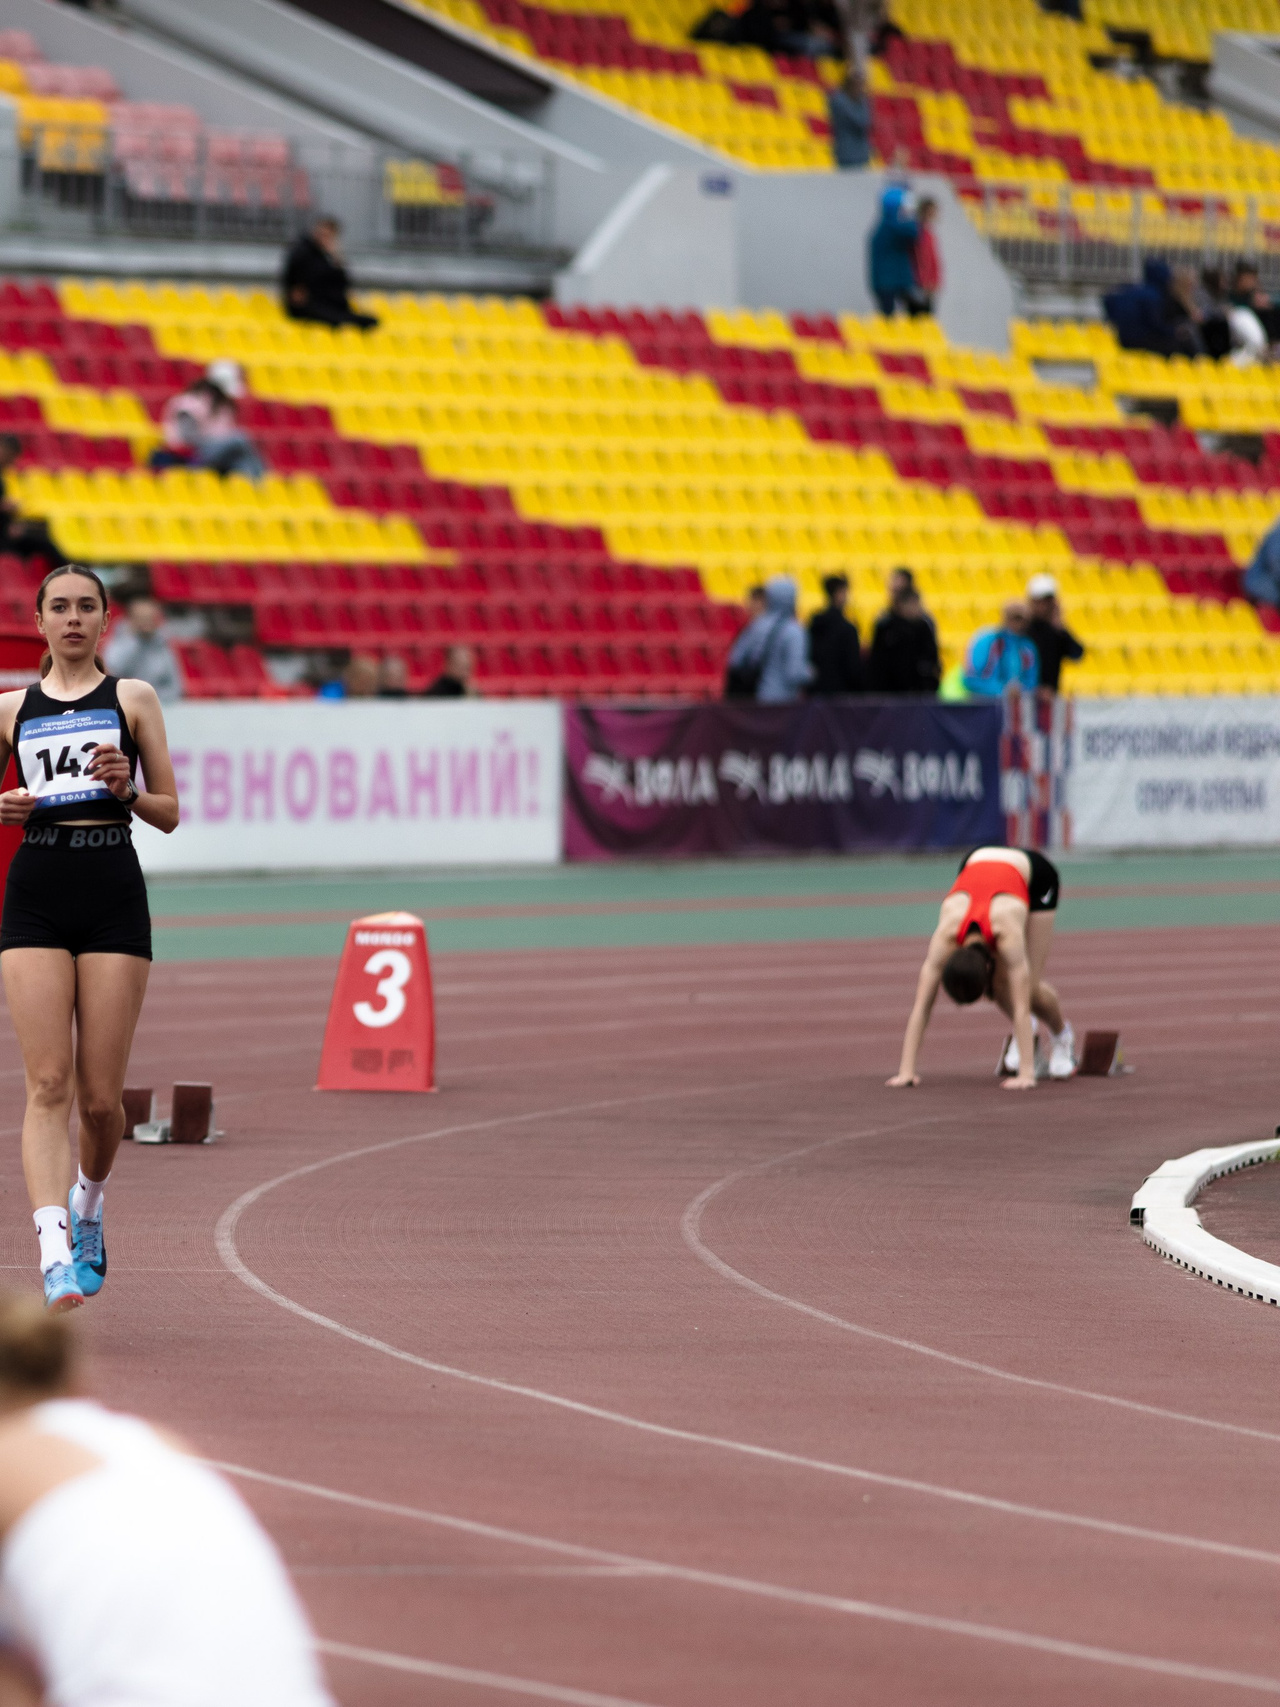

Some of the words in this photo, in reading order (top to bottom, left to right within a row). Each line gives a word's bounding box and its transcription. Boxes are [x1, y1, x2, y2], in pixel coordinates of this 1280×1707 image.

[40, 716, 92, 728] ПЕРВЕНСТВО
[60, 792, 87, 802] ВФЛА
[23, 826, 60, 846] ON
[69, 826, 131, 848] BODY
[352, 949, 412, 1028] 3
